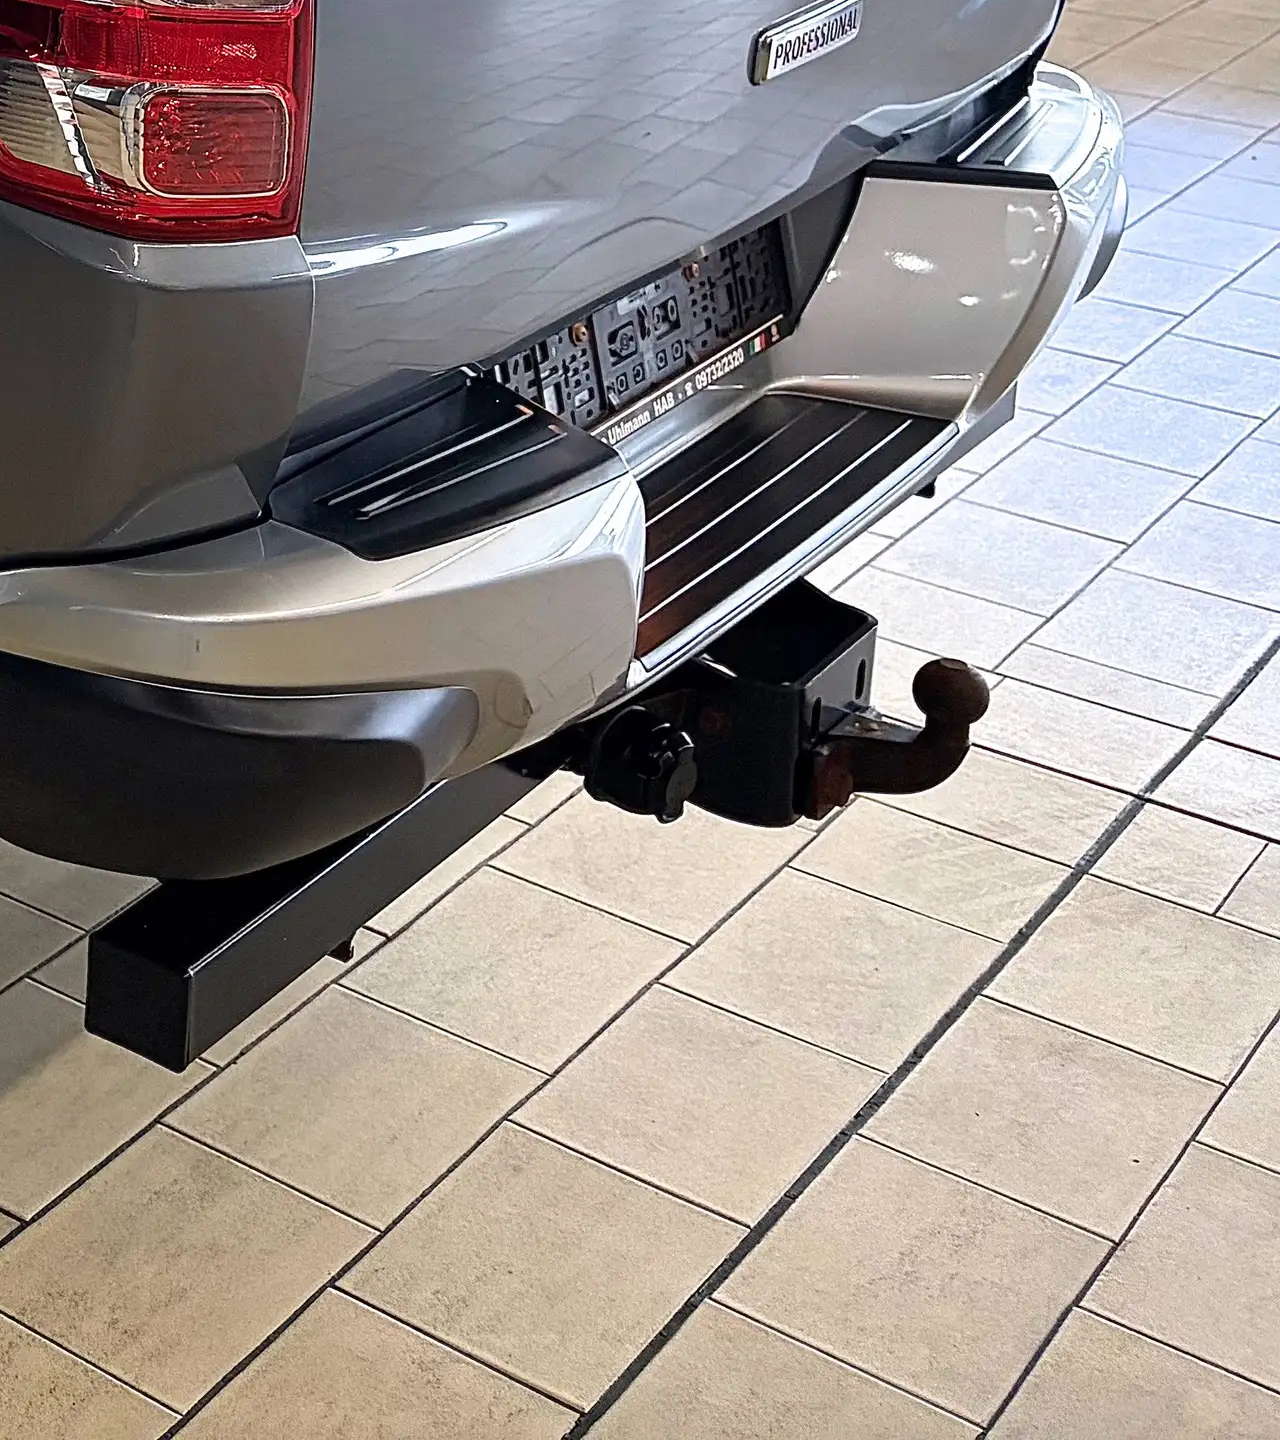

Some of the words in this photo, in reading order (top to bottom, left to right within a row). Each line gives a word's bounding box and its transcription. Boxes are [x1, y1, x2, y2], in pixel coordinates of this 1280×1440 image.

[773, 7, 858, 70] PROFESSIONAL
[606, 410, 652, 444] Uhlmann
[652, 391, 676, 418] HAB
[695, 347, 745, 390] 09732/2320
